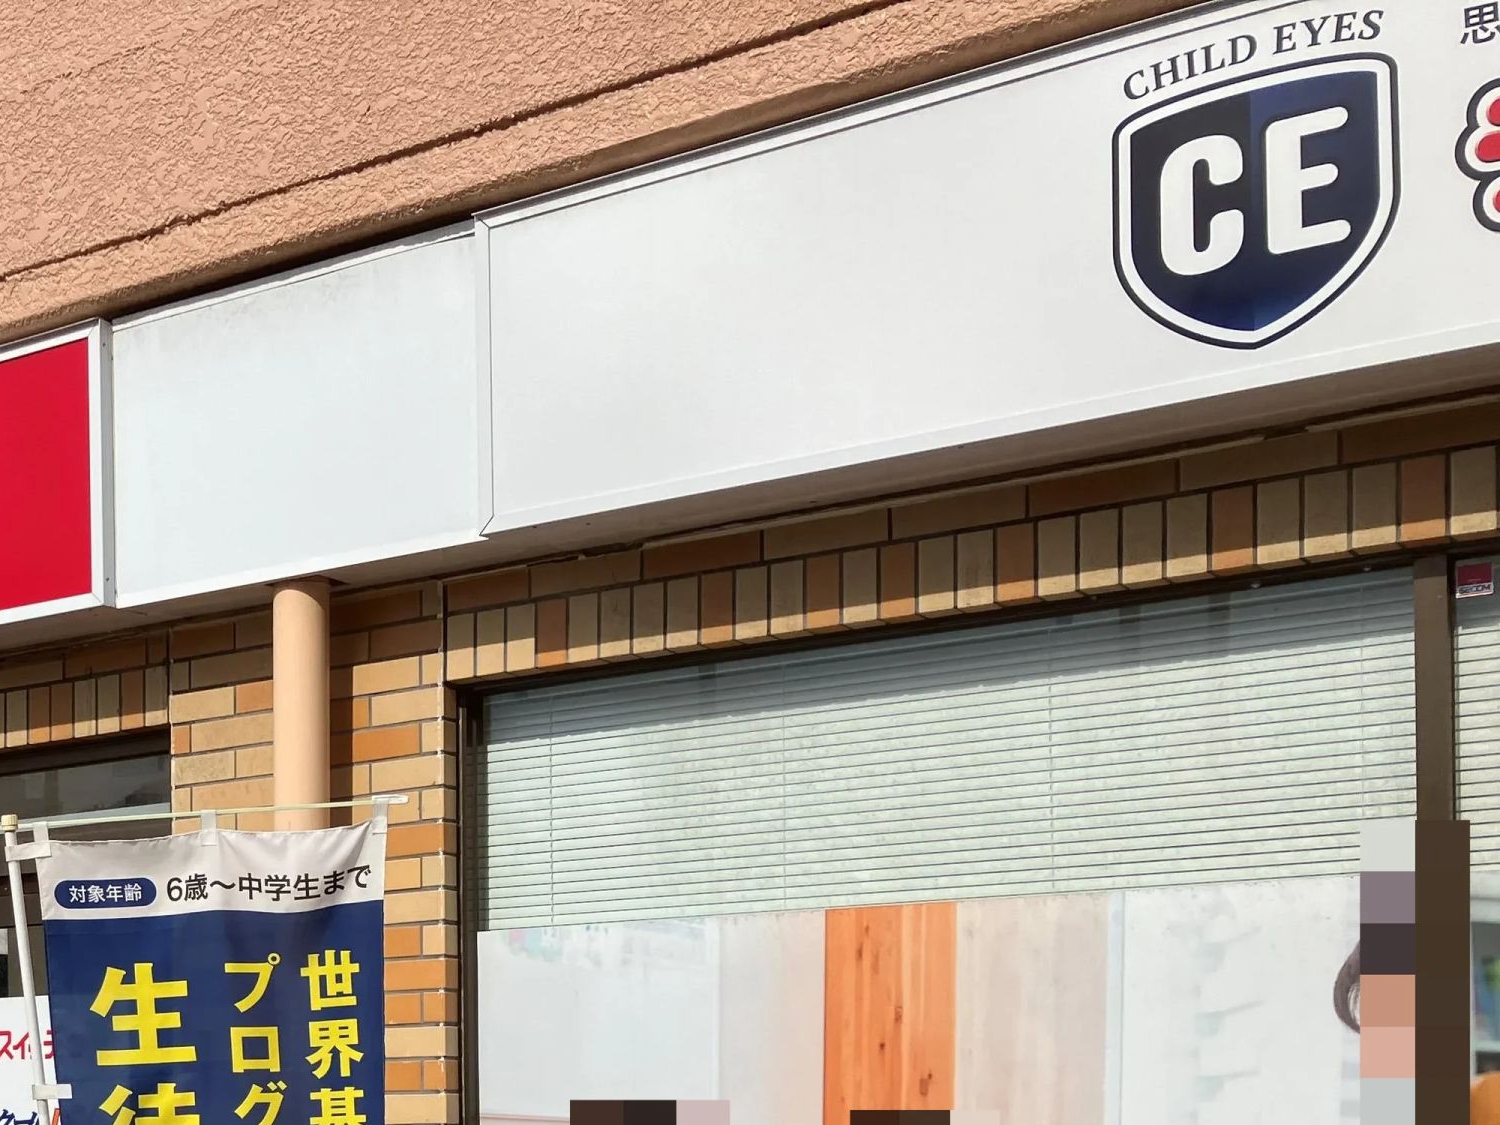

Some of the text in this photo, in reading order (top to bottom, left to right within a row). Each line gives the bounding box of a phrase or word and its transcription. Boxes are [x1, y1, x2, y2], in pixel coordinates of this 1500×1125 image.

[1123, 9, 1384, 100] CHILD EYES
[1160, 105, 1351, 276] CE
[69, 884, 142, 903] 対象年齢
